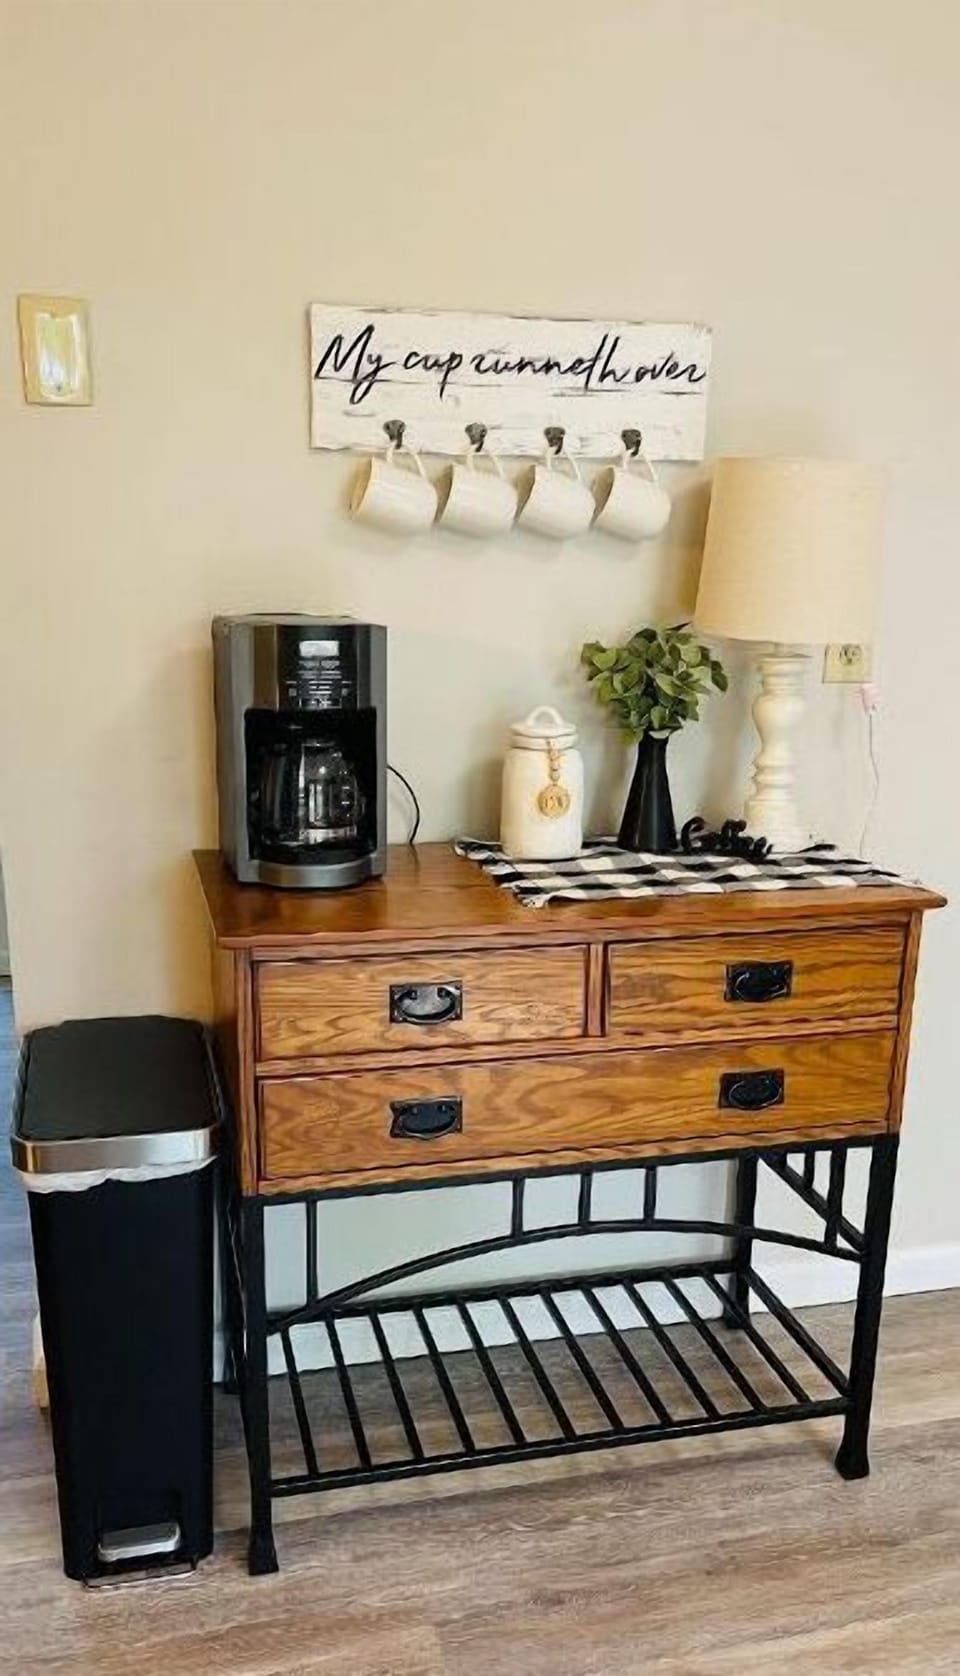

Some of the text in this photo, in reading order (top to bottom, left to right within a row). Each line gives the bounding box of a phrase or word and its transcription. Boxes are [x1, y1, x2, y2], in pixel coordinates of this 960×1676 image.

[314, 323, 707, 405] My cup runneth over
